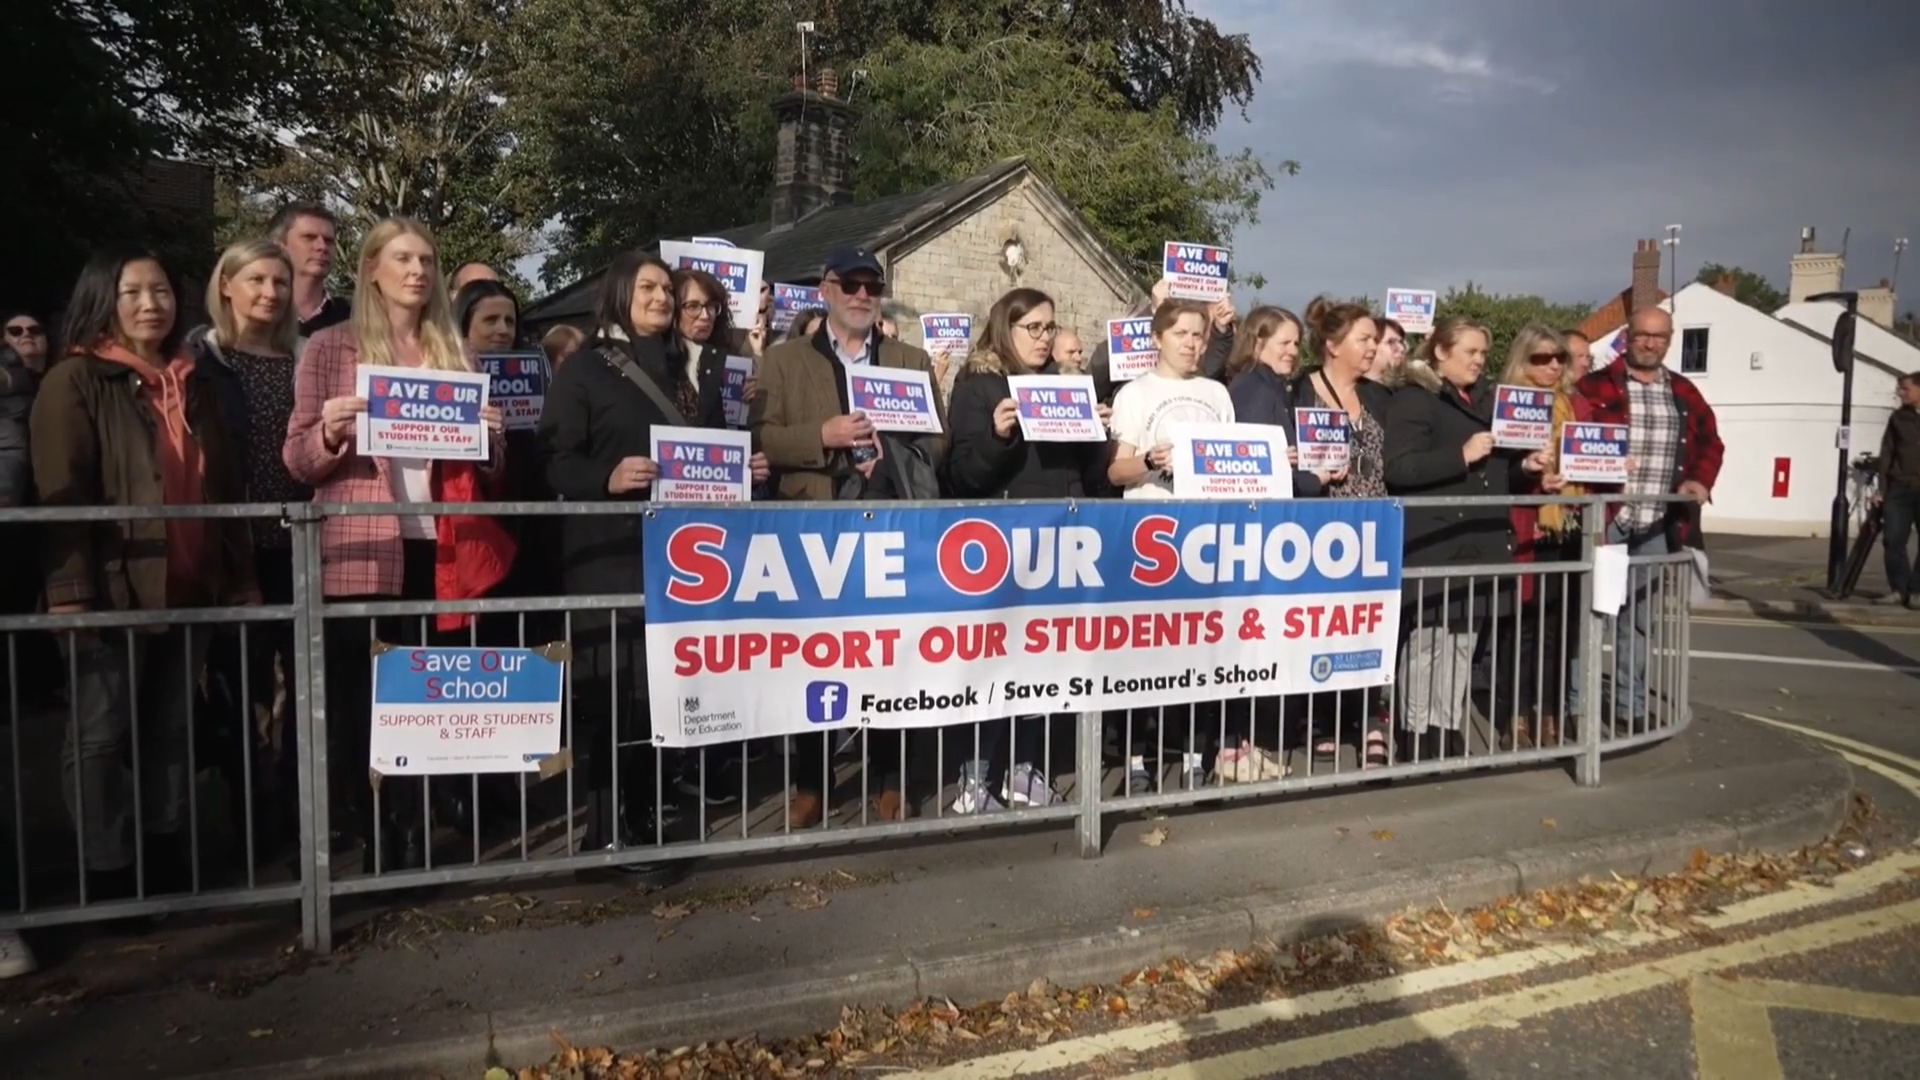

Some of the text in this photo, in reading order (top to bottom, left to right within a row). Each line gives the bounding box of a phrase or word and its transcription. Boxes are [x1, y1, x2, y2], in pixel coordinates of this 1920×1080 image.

[1168, 245, 1228, 263] SAVE OUR
[718, 263, 745, 277] OUR
[1175, 259, 1221, 276] SCHOOL
[1111, 321, 1152, 336] SAVE
[1121, 337, 1152, 352] SCH
[504, 359, 539, 377] OUR
[373, 377, 478, 404] SAVE OUR
[490, 379, 532, 394] HOOL
[854, 377, 923, 398] SAVE OUR
[864, 394, 918, 411] SCHOOL
[1020, 388, 1088, 405] SAVE OUR
[1499, 387, 1534, 404] SAVE
[385, 399, 464, 421] SCHOOL
[1031, 403, 1083, 418] SCHOOL
[1299, 411, 1330, 425] SAVE
[391, 423, 460, 434] SUPPORT OUR
[1566, 426, 1626, 441] SAVE OUR
[378, 432, 429, 442] STUDENTS
[444, 435, 473, 444] STAFF
[661, 443, 741, 464] SAVE OUR
[1195, 441, 1268, 458] SAVE OUR
[1571, 440, 1621, 455] SCHOOL
[672, 461, 731, 481] SCHOOL
[1205, 458, 1261, 473] SCHOOL
[664, 491, 704, 500] STUDENTS
[675, 483, 727, 492] SUPPORT OUR
[665, 514, 1389, 605] SAVE OUR SCHOOL
[674, 602, 1384, 677] SUPPORT OUR STUDENTS & STAFF
[410, 649, 527, 672] Save Our
[425, 676, 508, 699] School
[860, 662, 1278, 713] Facebook / Save St Leonard's School
[380, 712, 555, 727] SUPPORT OUR STUDENTS
[684, 711, 736, 725] Department
[439, 727, 497, 740] & STAFF
[685, 722, 743, 736] for Education
